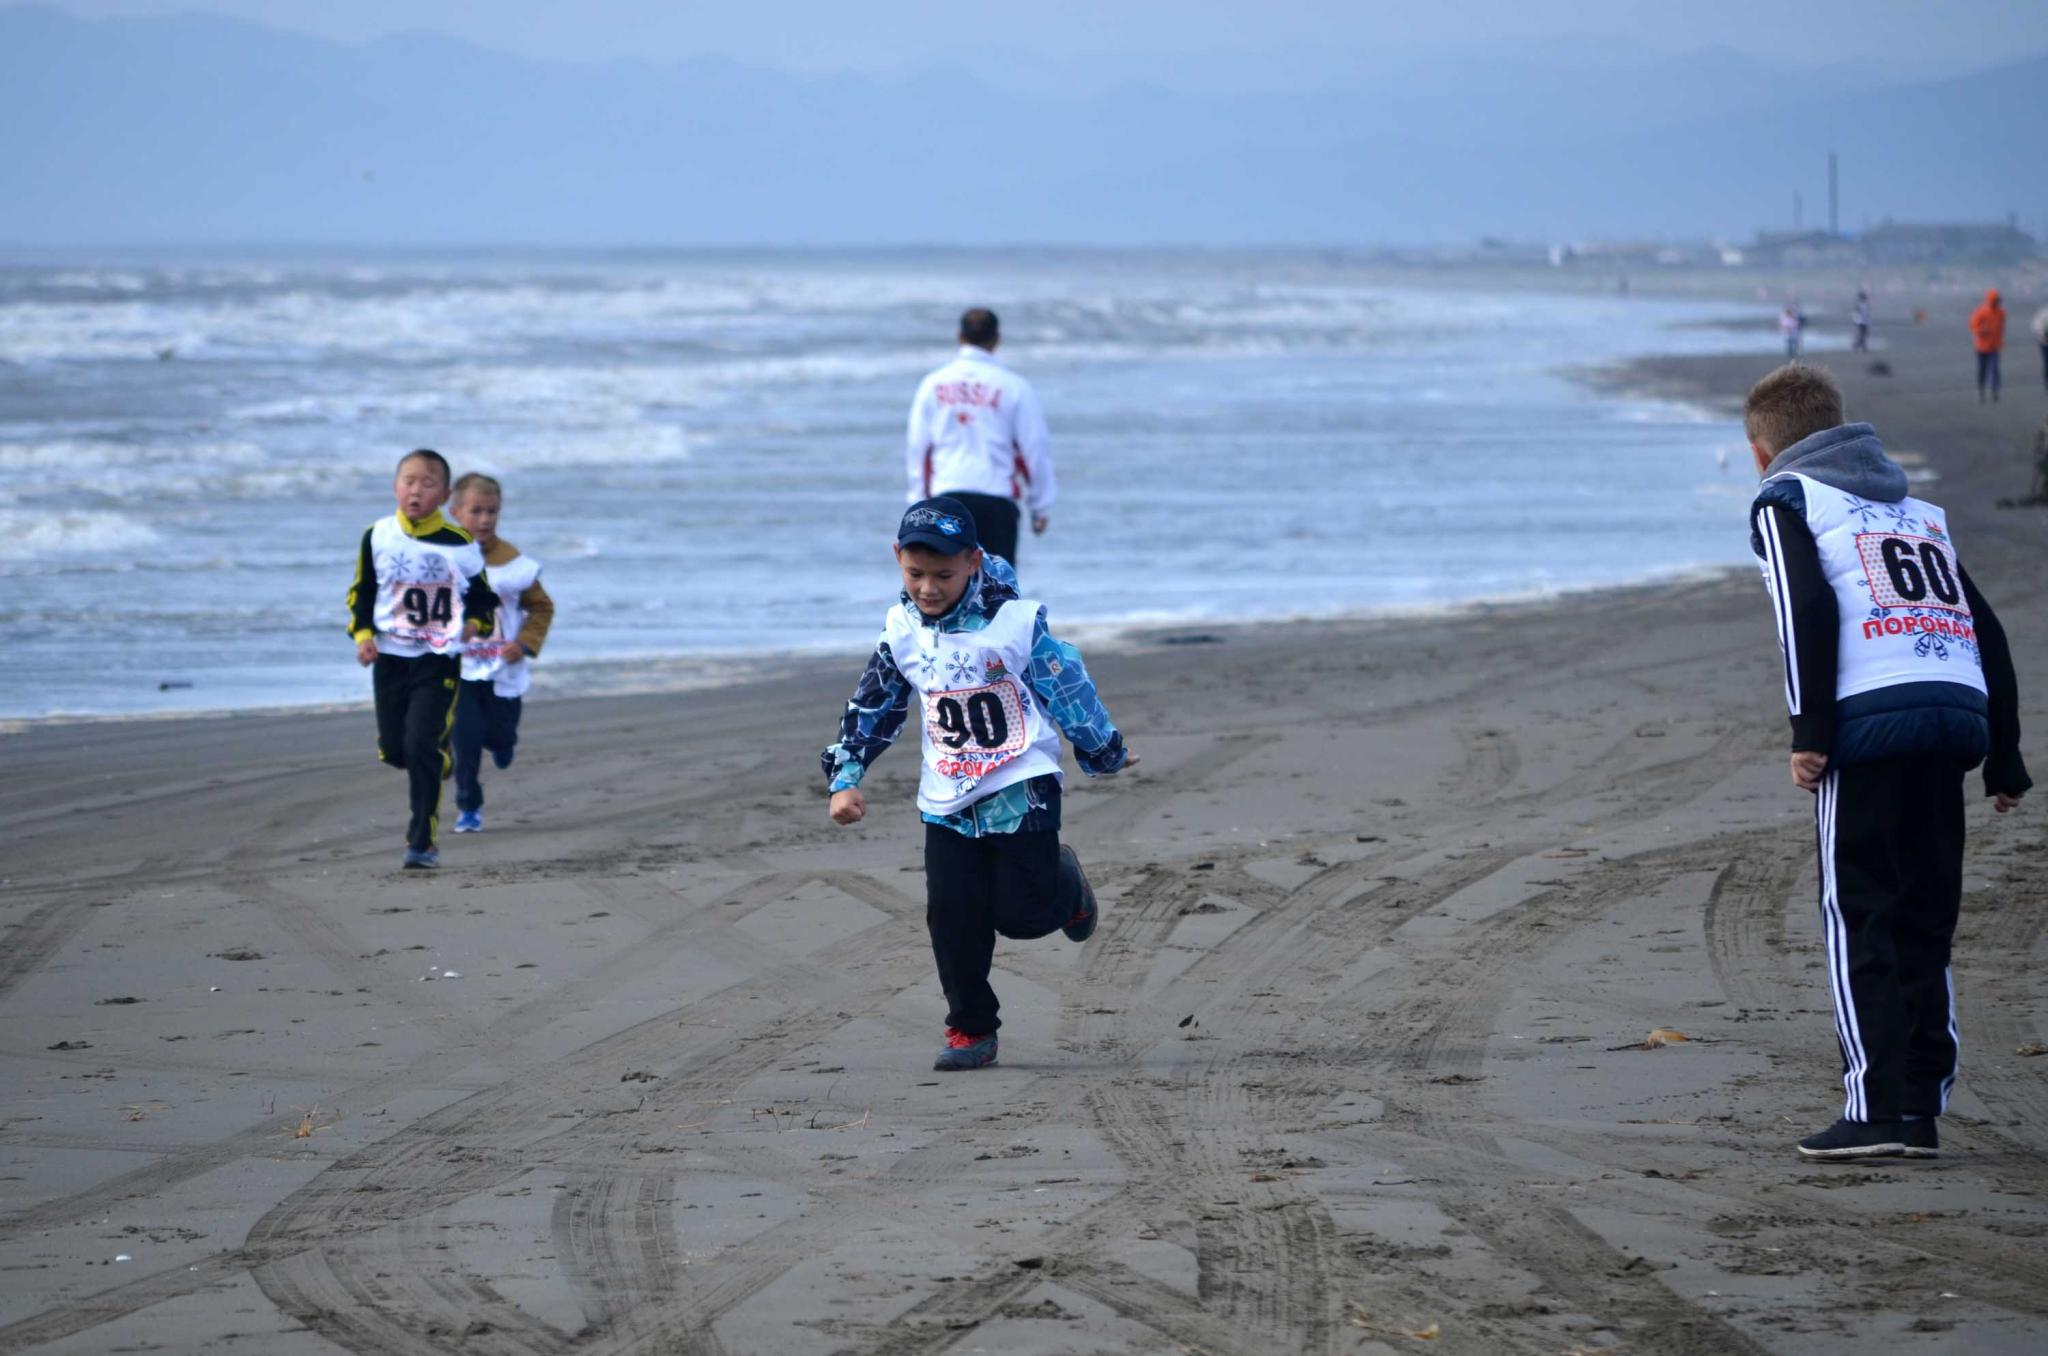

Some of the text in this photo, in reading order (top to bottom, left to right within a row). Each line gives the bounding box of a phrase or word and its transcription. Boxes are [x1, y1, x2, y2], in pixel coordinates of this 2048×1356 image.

[935, 382, 1002, 410] RUSSIA
[1881, 537, 1960, 605] 60
[403, 587, 453, 627] 94
[937, 692, 1008, 749] 90
